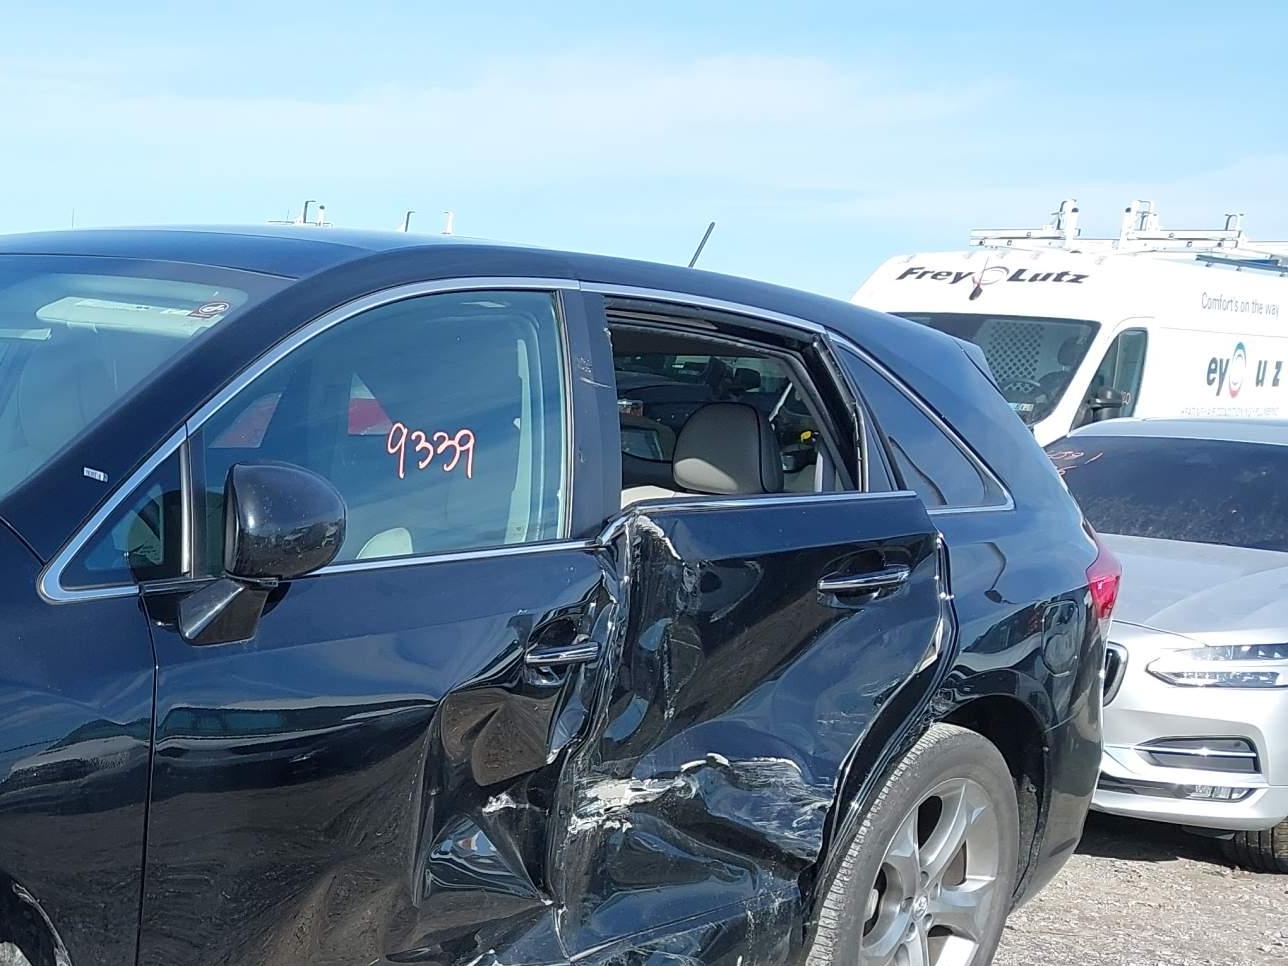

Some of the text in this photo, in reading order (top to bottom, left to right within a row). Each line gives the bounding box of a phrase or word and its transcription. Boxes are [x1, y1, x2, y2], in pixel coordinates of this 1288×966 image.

[895, 266, 1090, 285] Frey Lutz
[386, 421, 476, 480] 9339
